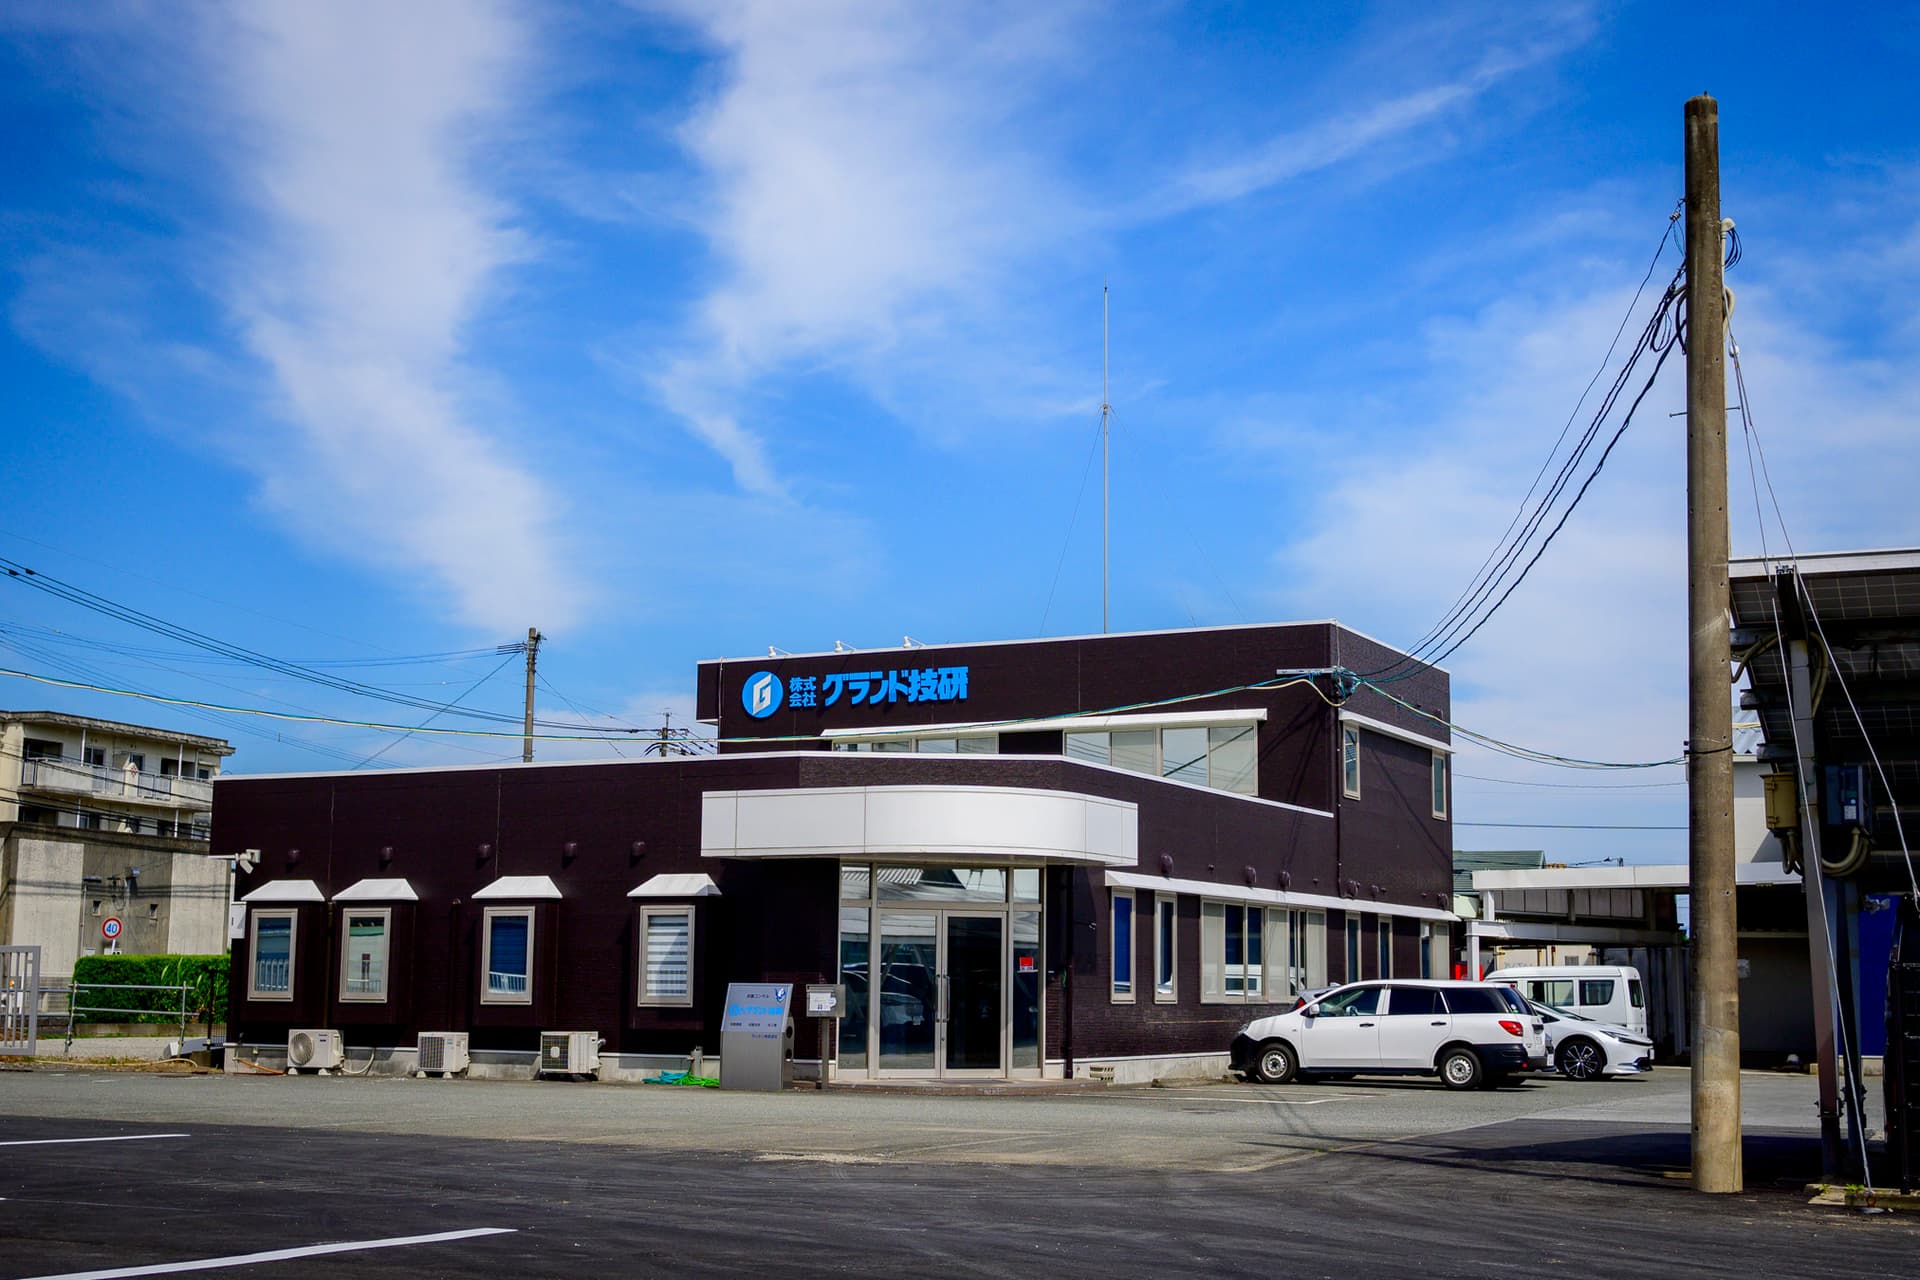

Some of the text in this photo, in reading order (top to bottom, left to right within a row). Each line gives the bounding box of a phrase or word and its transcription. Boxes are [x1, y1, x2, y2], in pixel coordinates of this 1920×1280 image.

[789, 676, 817, 692] 株式
[822, 666, 969, 707] グランド技研
[789, 692, 817, 707] 会社
[106, 922, 118, 934] 40
